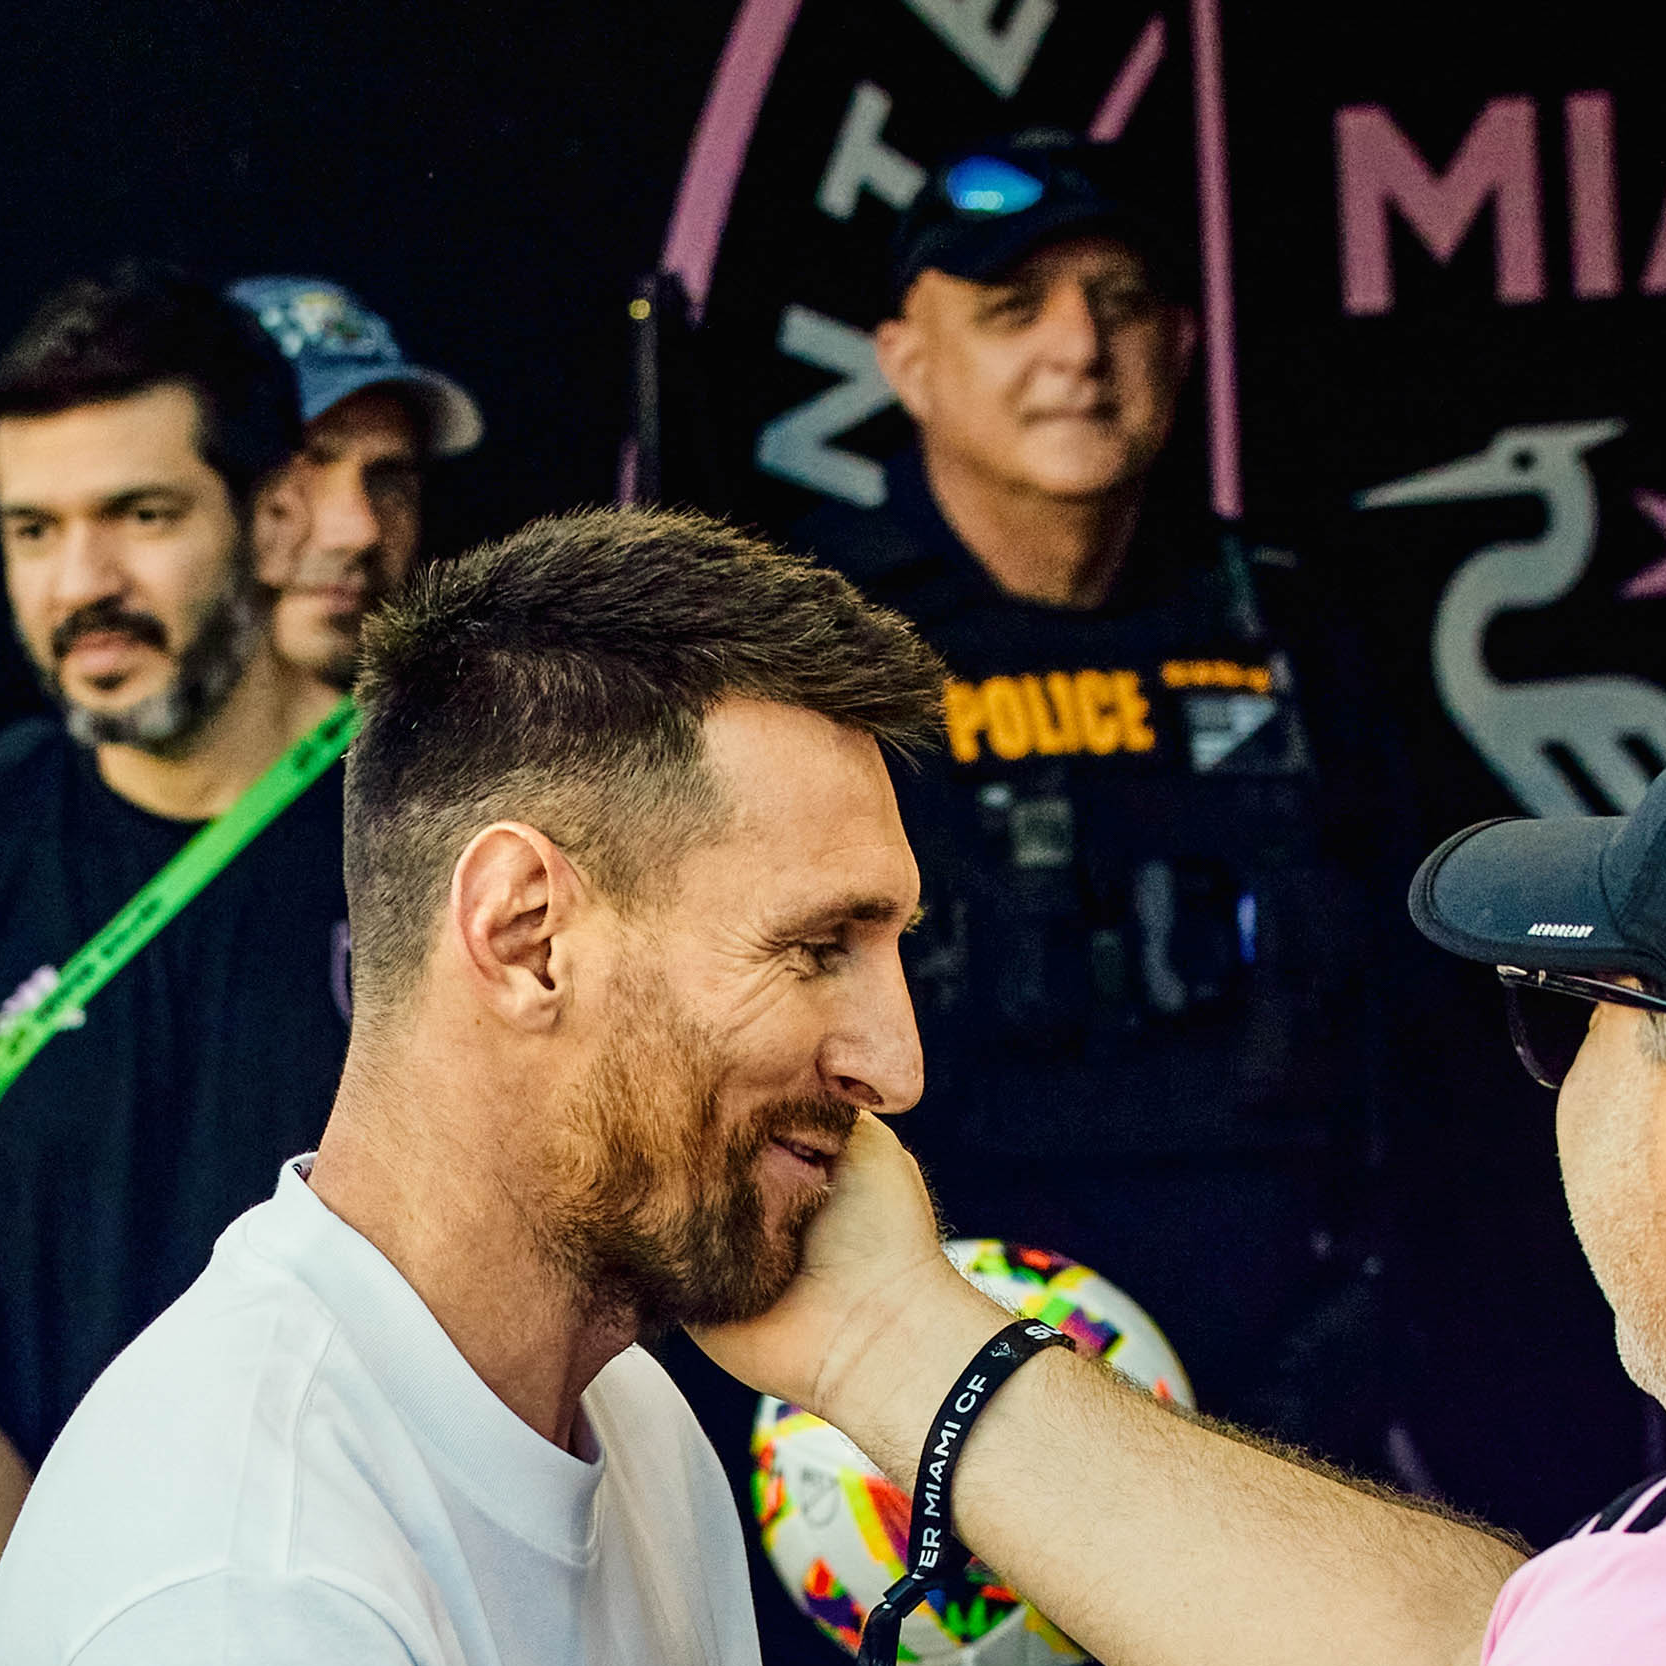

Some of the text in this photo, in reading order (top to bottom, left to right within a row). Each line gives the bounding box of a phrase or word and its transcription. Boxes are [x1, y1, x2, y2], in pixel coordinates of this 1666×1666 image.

[943, 667, 1158, 765] POLICE
[923, 1419, 963, 1518] MIAMI
[954, 1374, 988, 1414] CF
